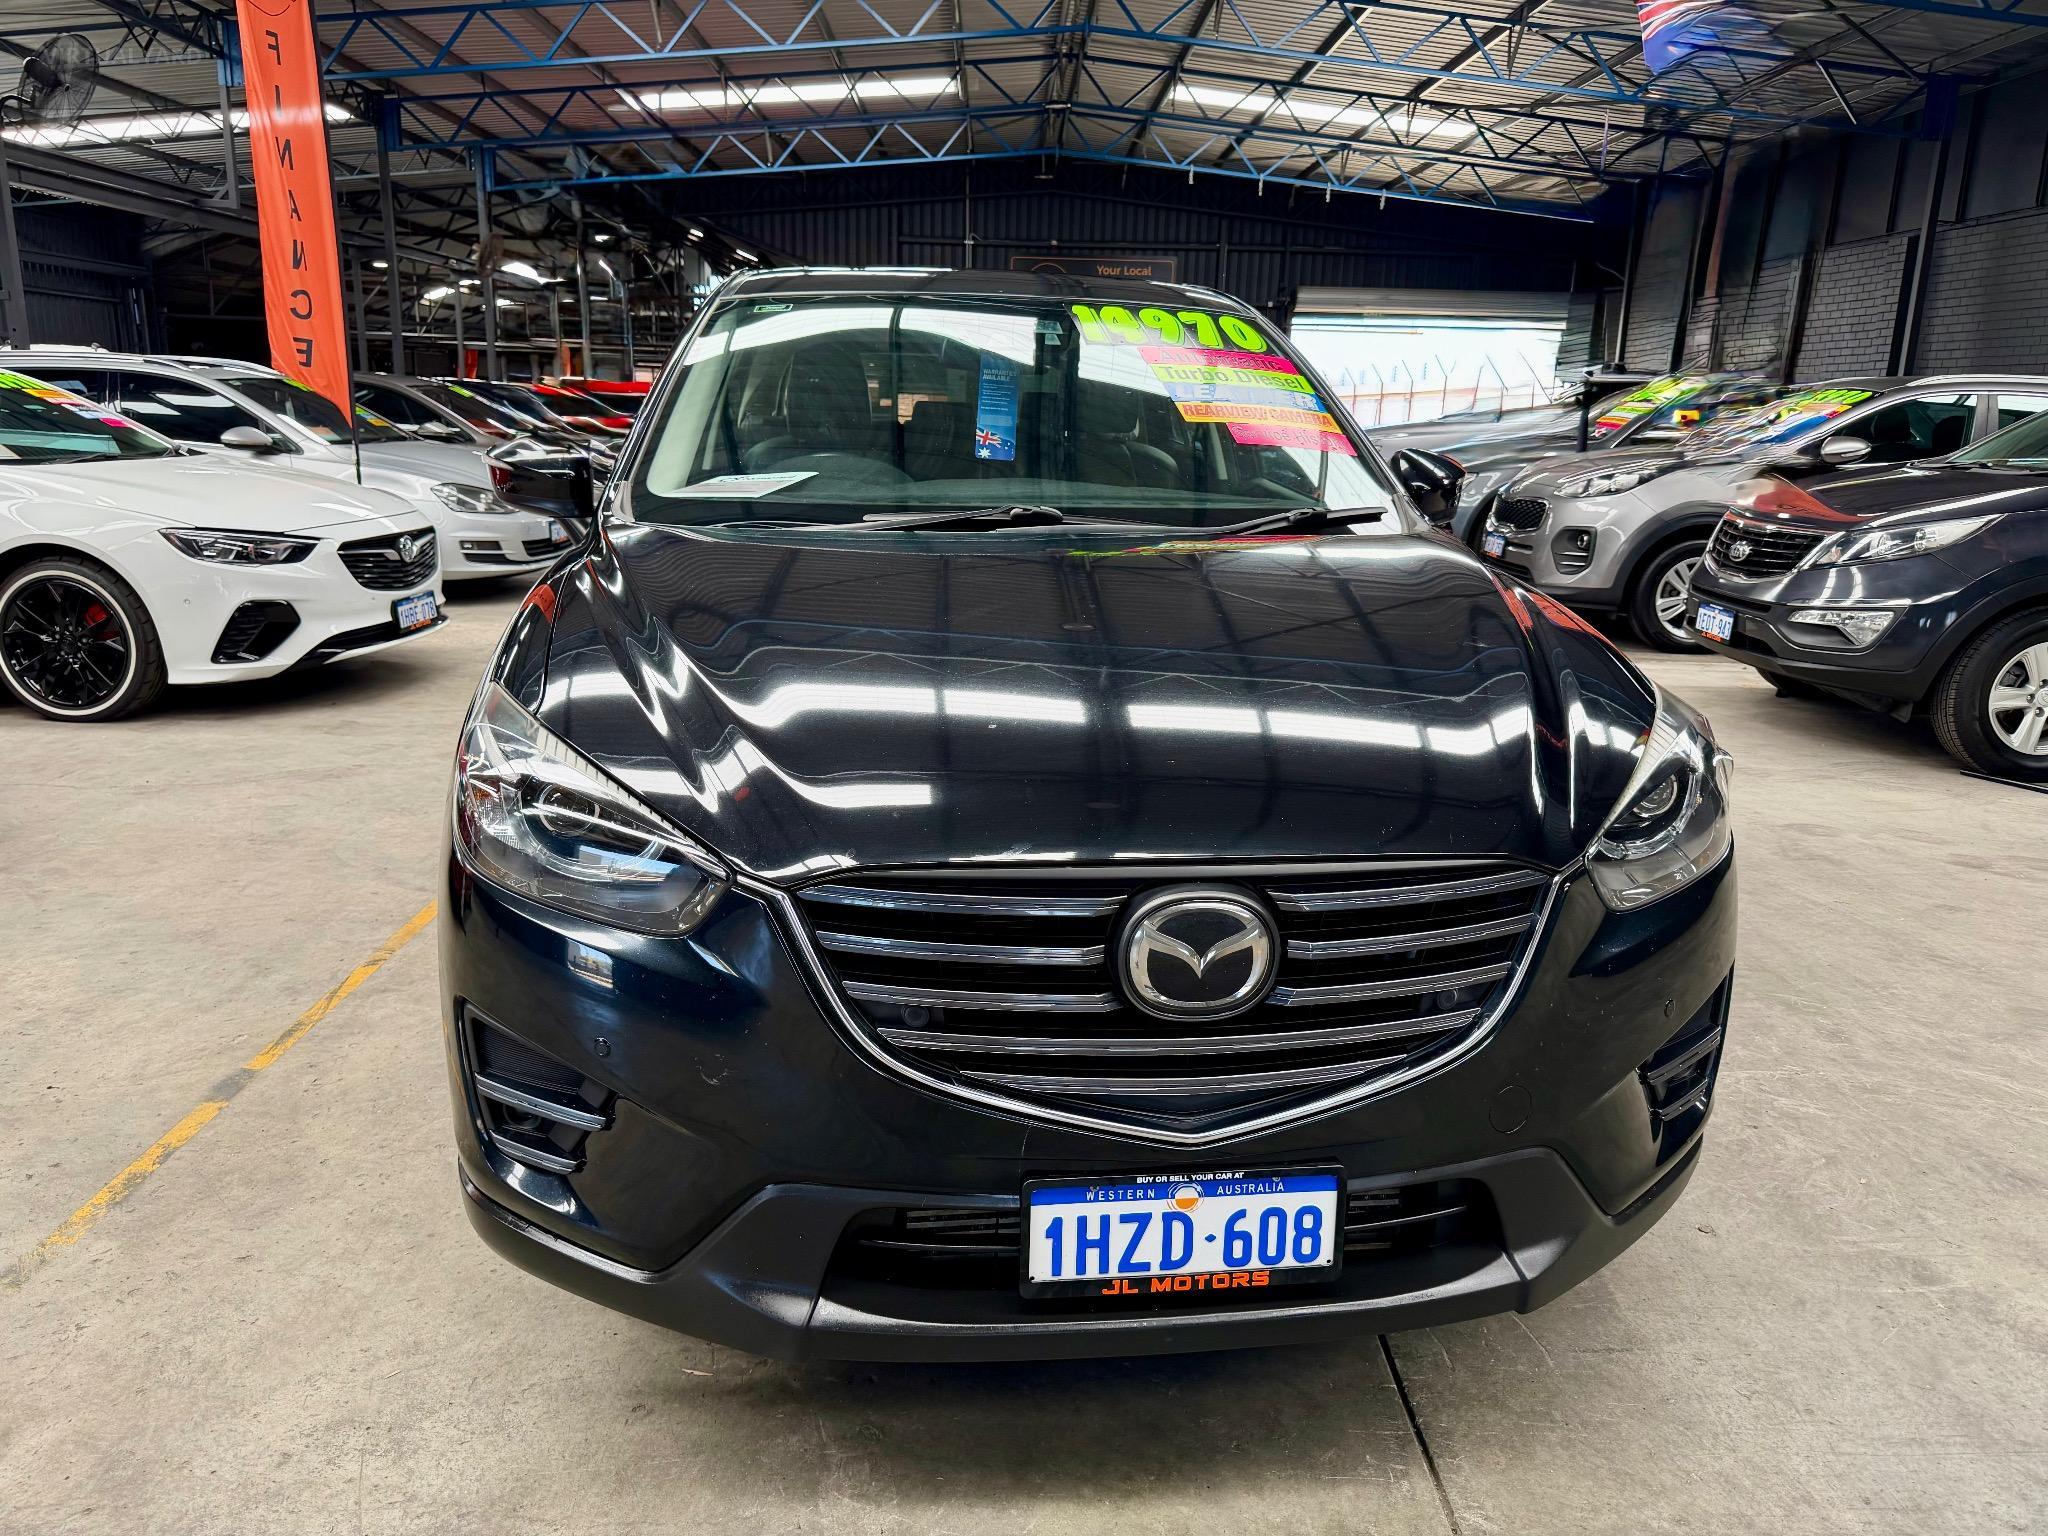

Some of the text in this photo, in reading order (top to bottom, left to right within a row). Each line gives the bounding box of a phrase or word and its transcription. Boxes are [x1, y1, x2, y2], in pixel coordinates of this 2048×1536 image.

[1097, 265, 1152, 277] Your Local
[1072, 304, 1268, 352] 14970
[1160, 350, 1282, 371] Automatic
[1159, 366, 1304, 390] Turbo Diesel
[1191, 1173, 1214, 1181] YOUR
[1215, 1172, 1232, 1180] CAR
[1233, 1171, 1245, 1180] AT
[1086, 1181, 1285, 1201] WESTERN AUSTRALIA
[1102, 1270, 1271, 1296] JL MOTORS
